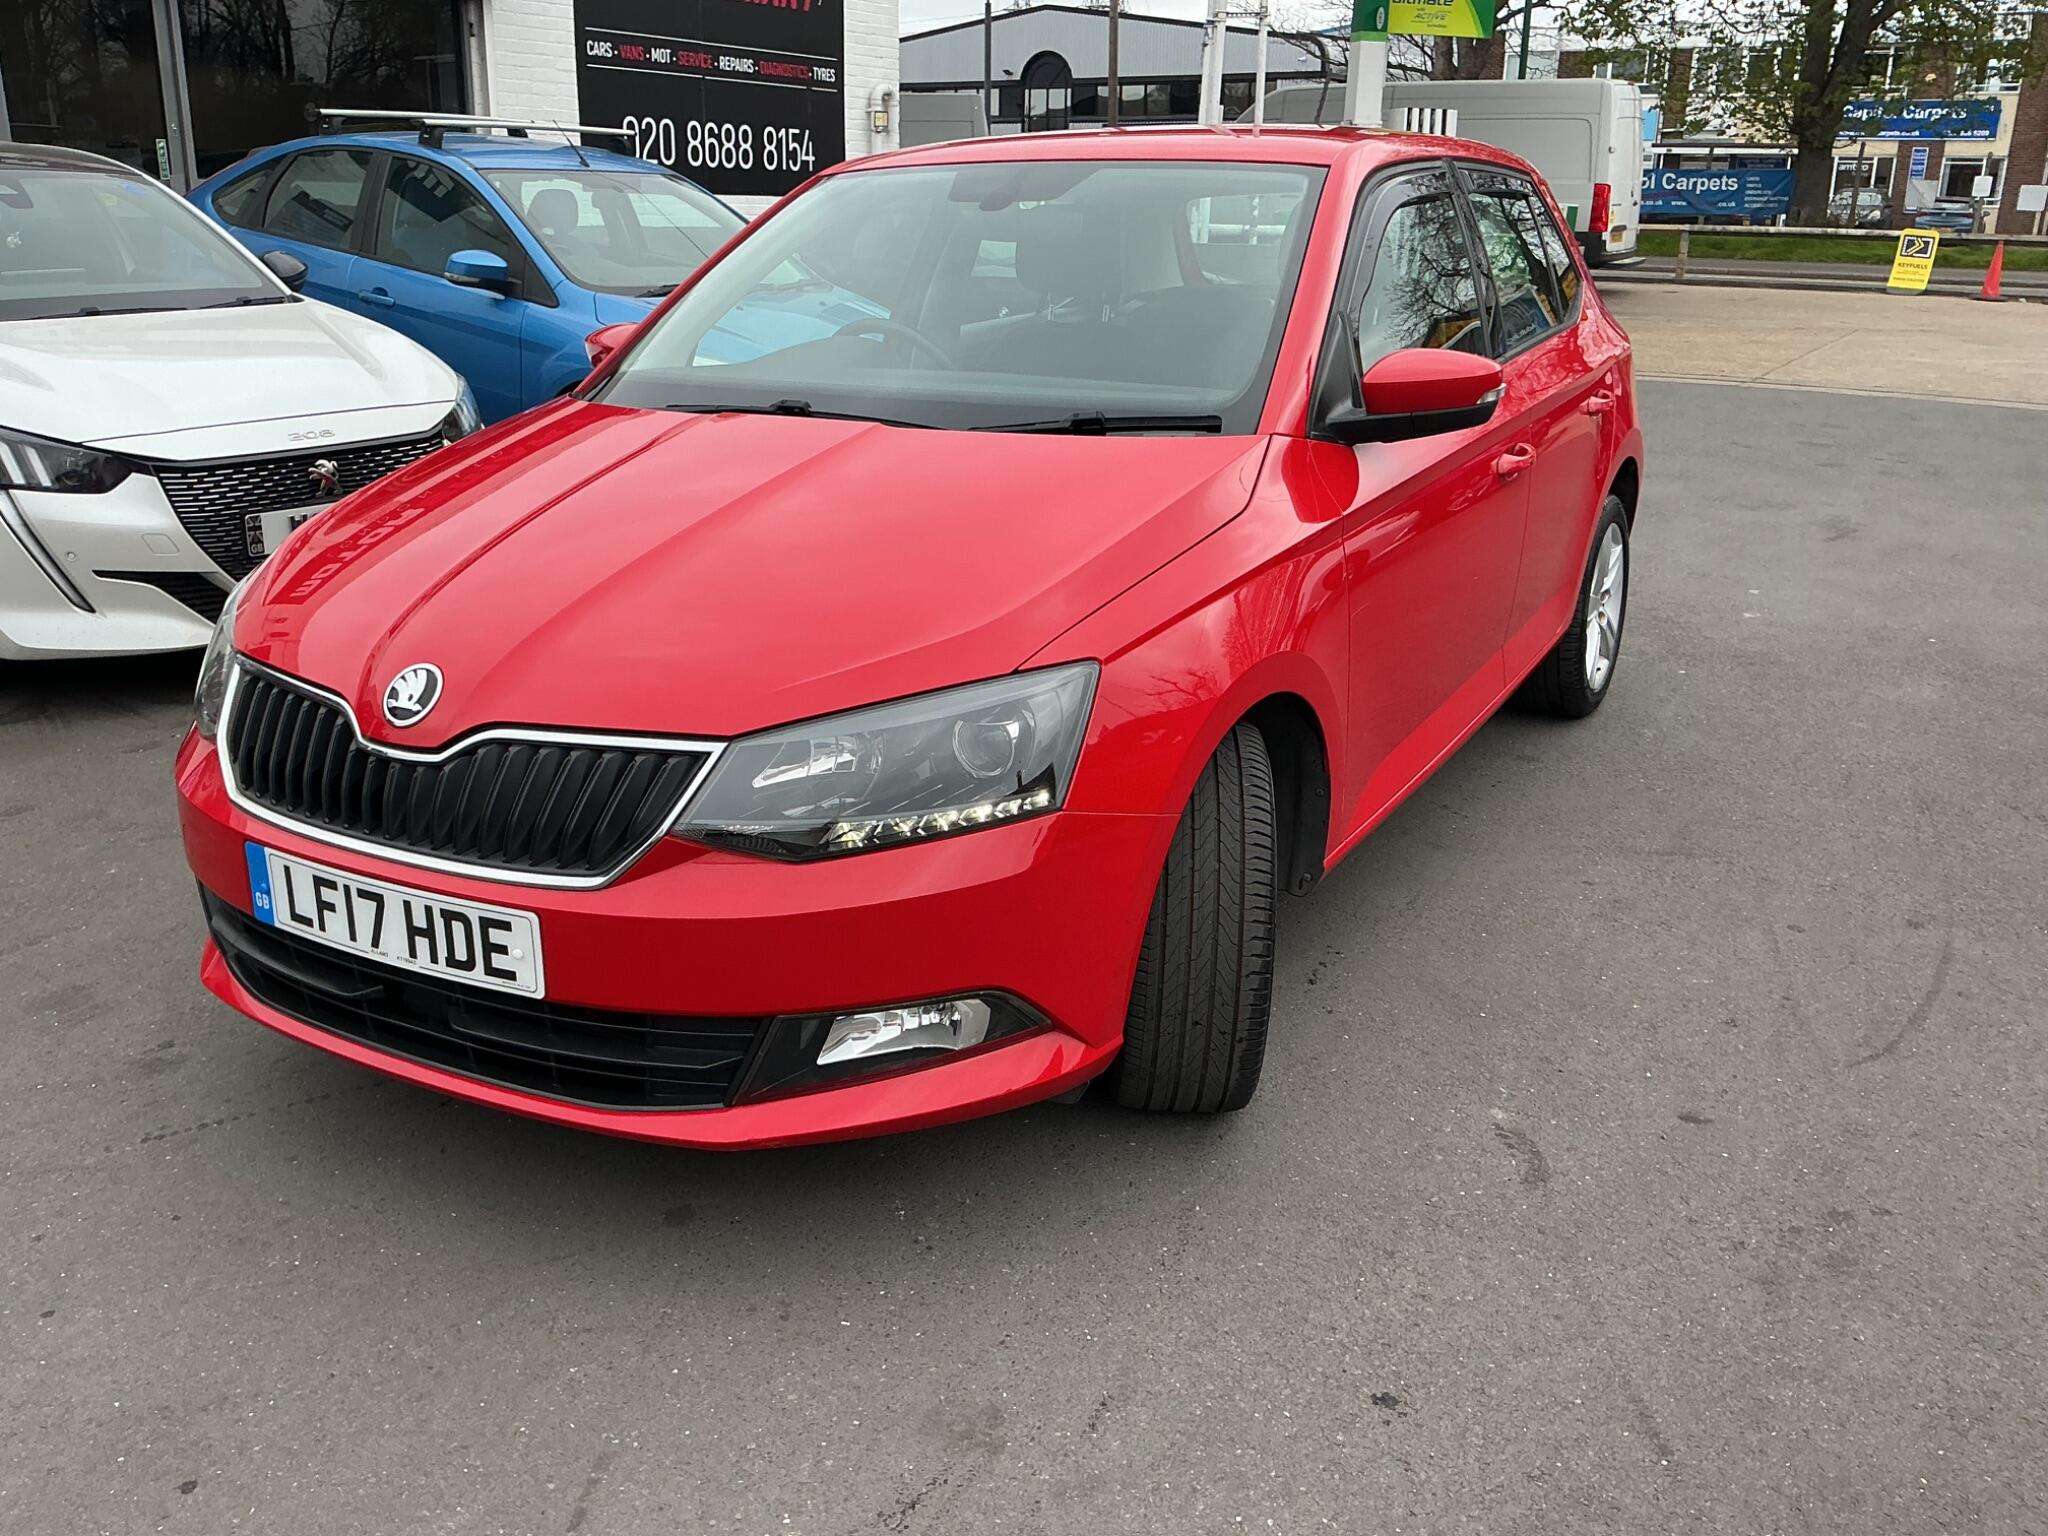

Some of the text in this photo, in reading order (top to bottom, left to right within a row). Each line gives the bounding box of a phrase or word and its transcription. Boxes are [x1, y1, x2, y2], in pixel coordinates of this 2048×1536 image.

[586, 40, 836, 82] CARS VANS MOT SERVICE REPAIRS DIAGNOSTICS TYRES
[1843, 105, 1897, 121] Capit
[687, 120, 754, 169] 8688
[763, 126, 815, 172] 8154
[1838, 163, 1869, 171] amto
[1662, 173, 1738, 194] Carpets
[288, 429, 336, 442] 208
[255, 893, 270, 910] GB
[284, 865, 517, 982] LF17 HDE
